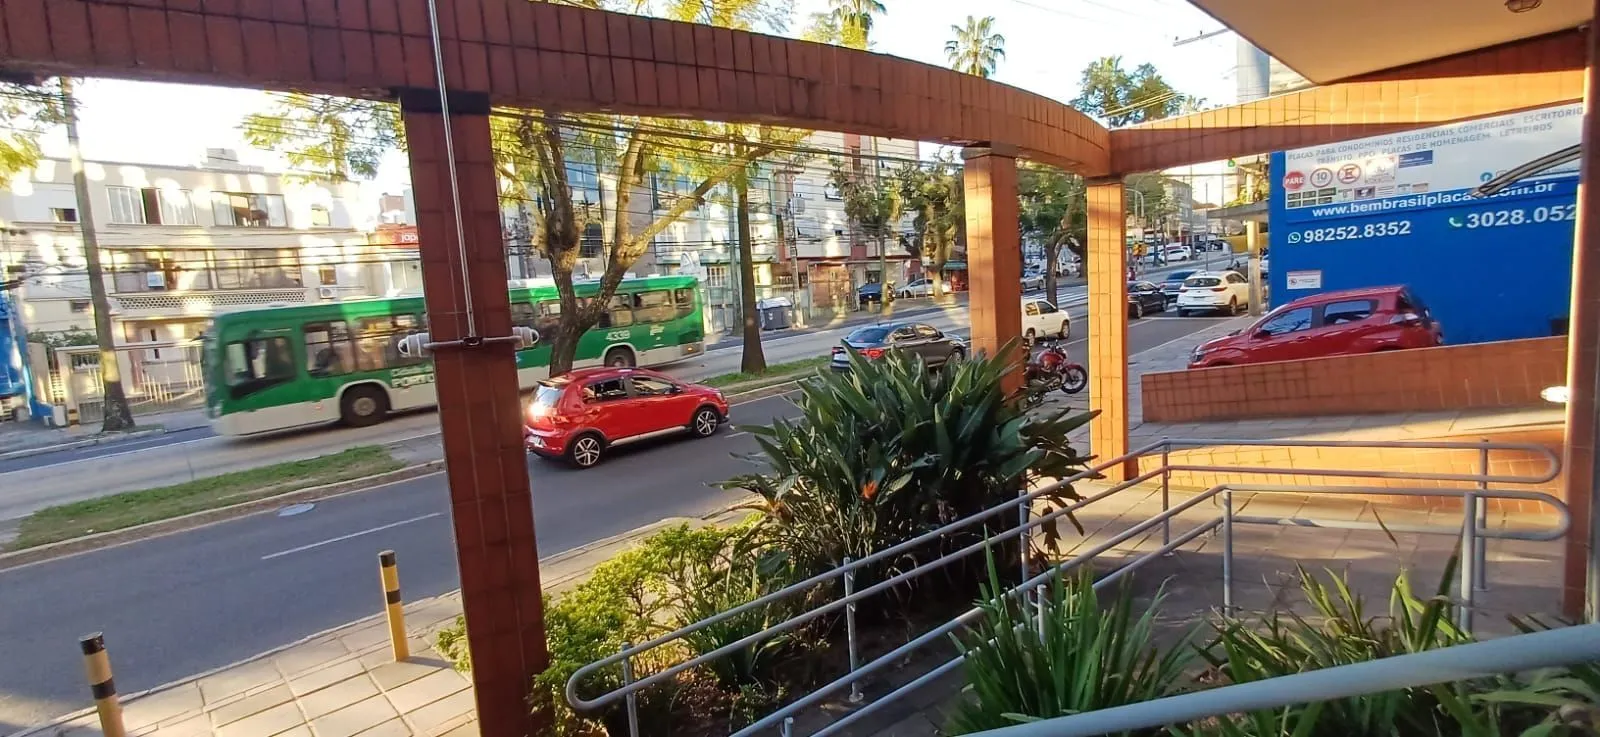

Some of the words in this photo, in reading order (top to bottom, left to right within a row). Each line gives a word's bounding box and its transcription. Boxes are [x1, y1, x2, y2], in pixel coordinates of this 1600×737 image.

[1288, 152, 1314, 161] PLACAS
[1396, 128, 1454, 144] RESIDENCIAIS
[1457, 118, 1515, 135] COMERCIAIS
[1382, 146, 1412, 155] PLACAS
[1415, 143, 1427, 151] DE
[1430, 132, 1491, 149] HOMENAGEM
[1500, 122, 1553, 138] LETREIROS
[1285, 177, 1304, 185] PARE
[1315, 171, 1328, 181] 10
[1303, 220, 1411, 243] 98252.8352
